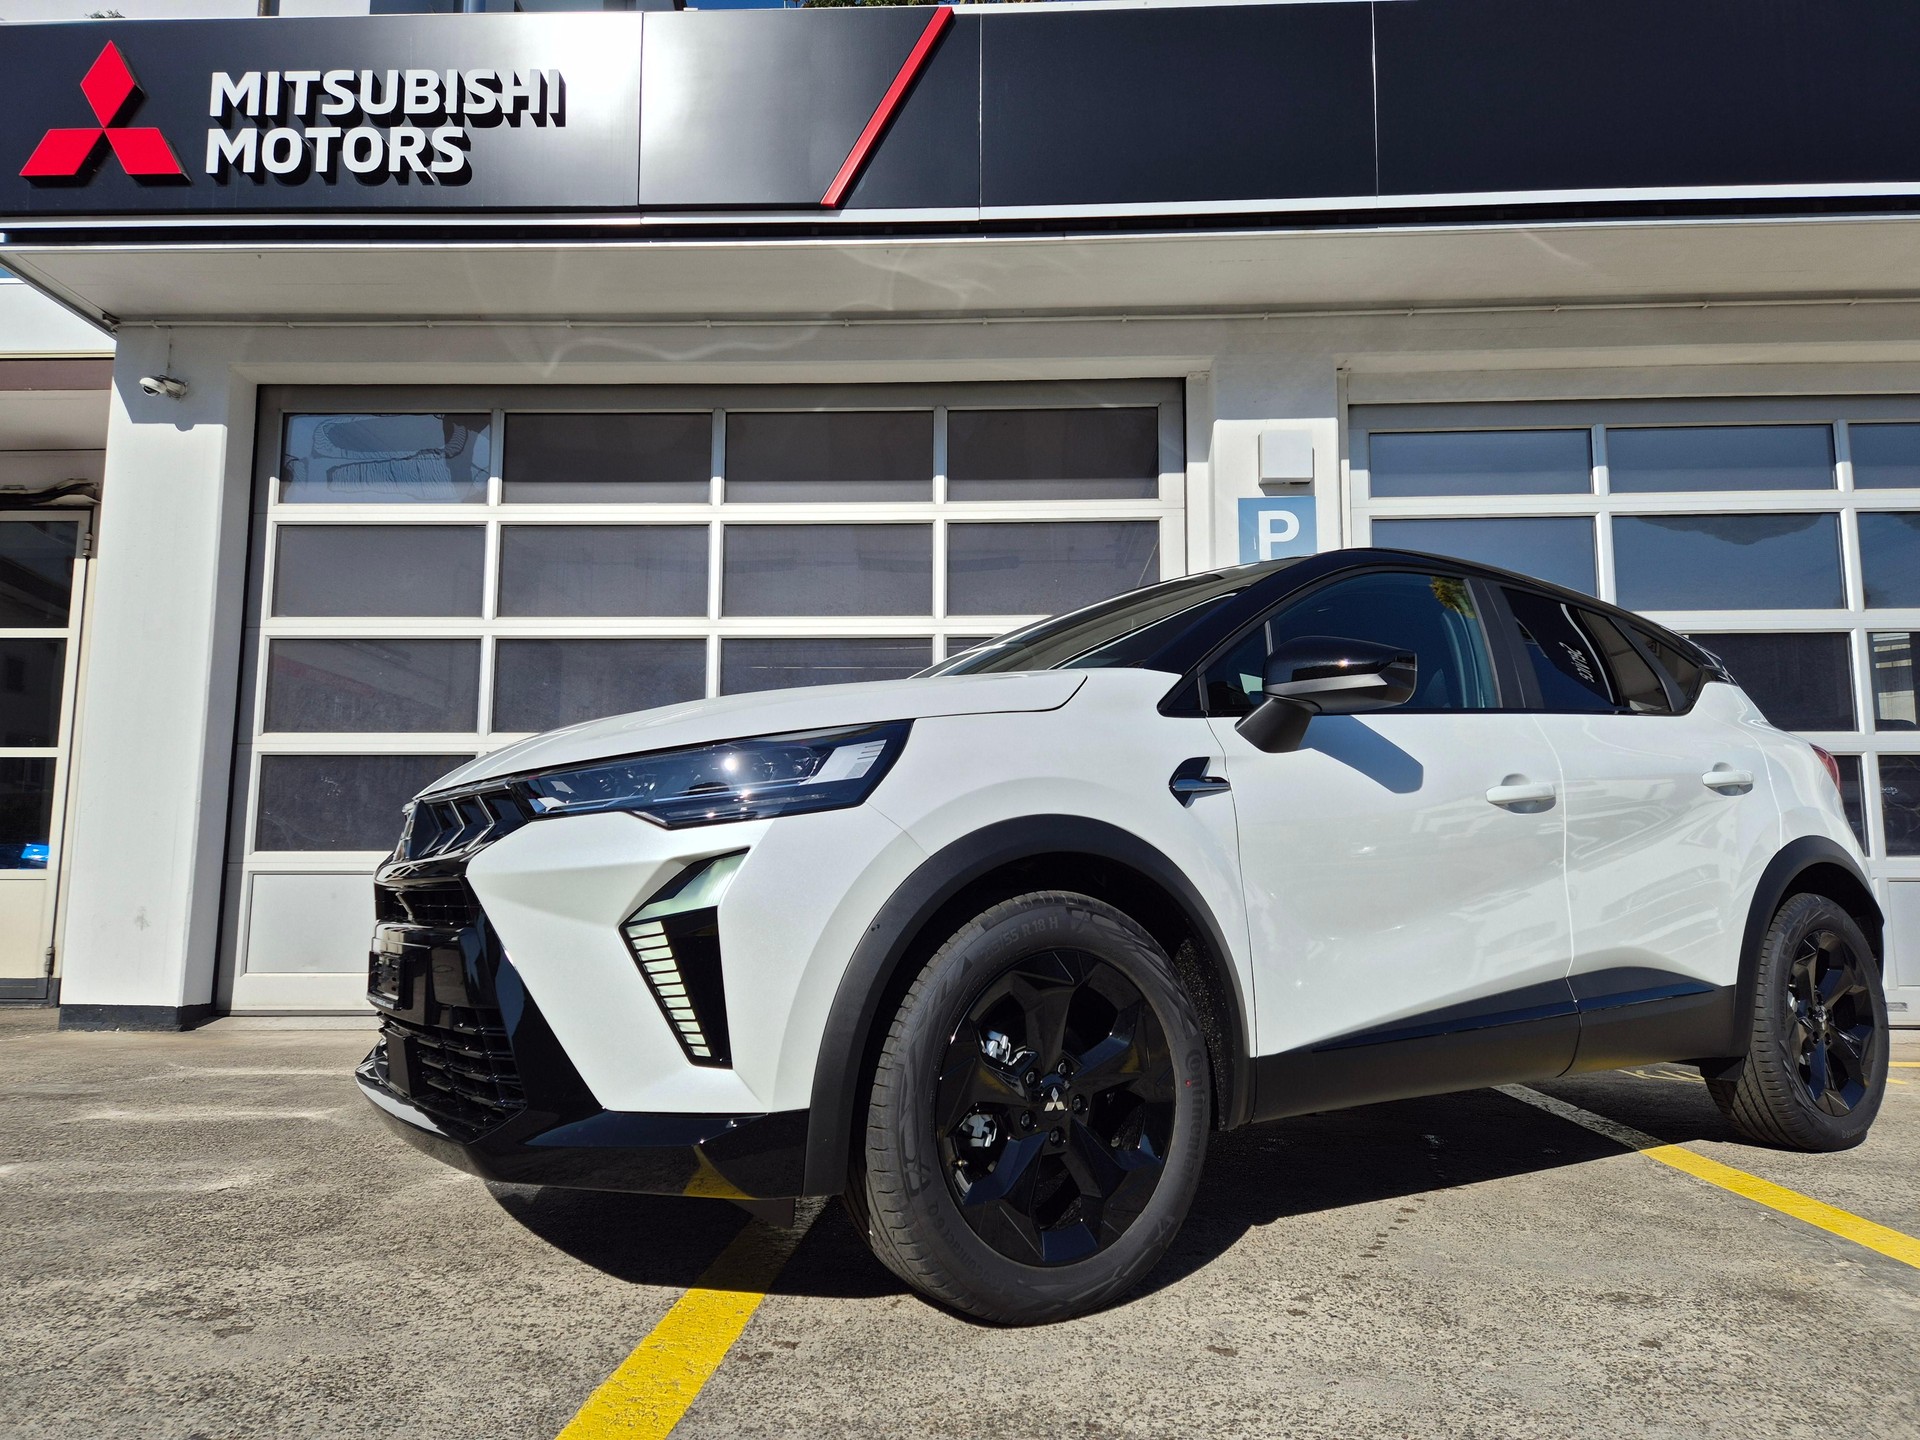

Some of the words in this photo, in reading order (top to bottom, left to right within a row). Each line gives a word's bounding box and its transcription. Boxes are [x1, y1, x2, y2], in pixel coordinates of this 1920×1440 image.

[210, 69, 560, 118] MITSUBISHI
[206, 126, 464, 174] MOTORS
[1258, 510, 1300, 561] P
